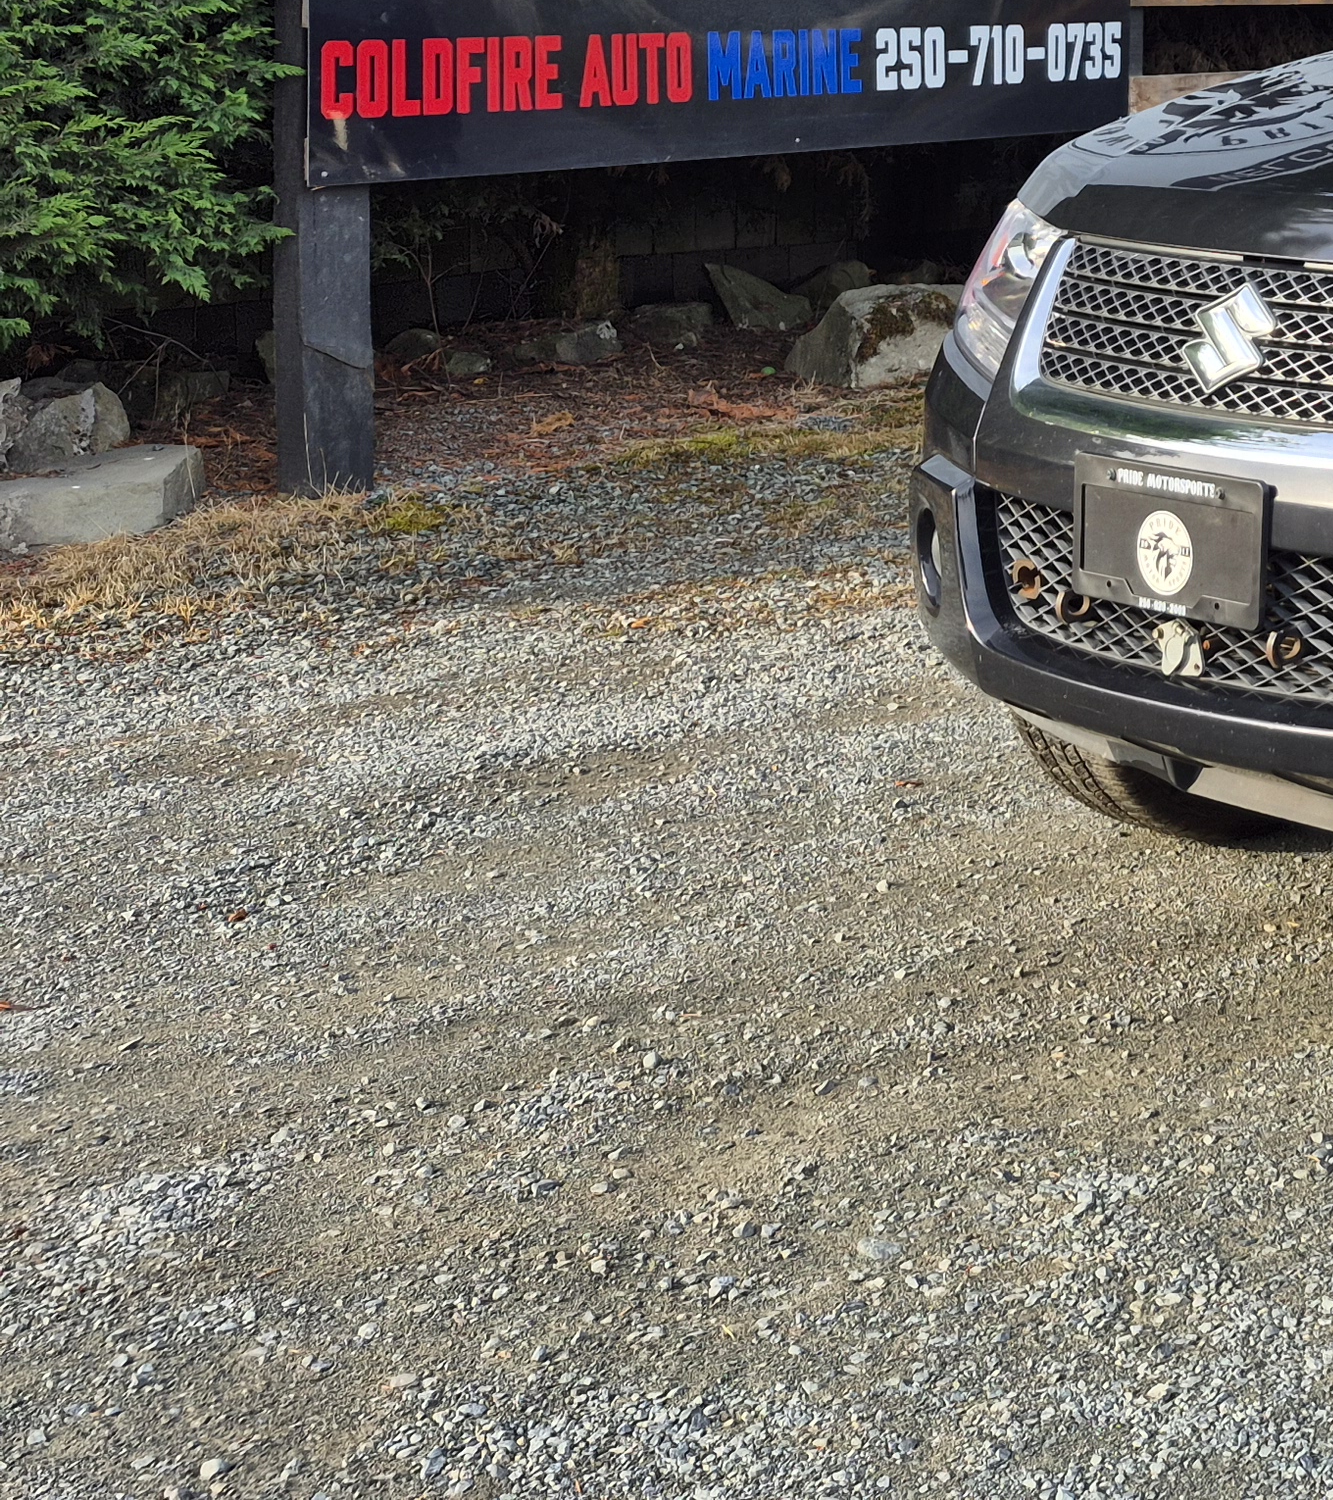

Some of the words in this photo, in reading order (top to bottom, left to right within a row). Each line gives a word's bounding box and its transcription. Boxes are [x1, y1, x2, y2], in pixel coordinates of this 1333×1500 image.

[320, 34, 563, 120] COLDFIRE
[579, 31, 694, 109] AUTO
[707, 28, 864, 101] MARINE
[875, 20, 1123, 92] 250-710-0735
[1117, 467, 1144, 488] PRIDE
[1146, 472, 1216, 499] MOTORSPORTS
